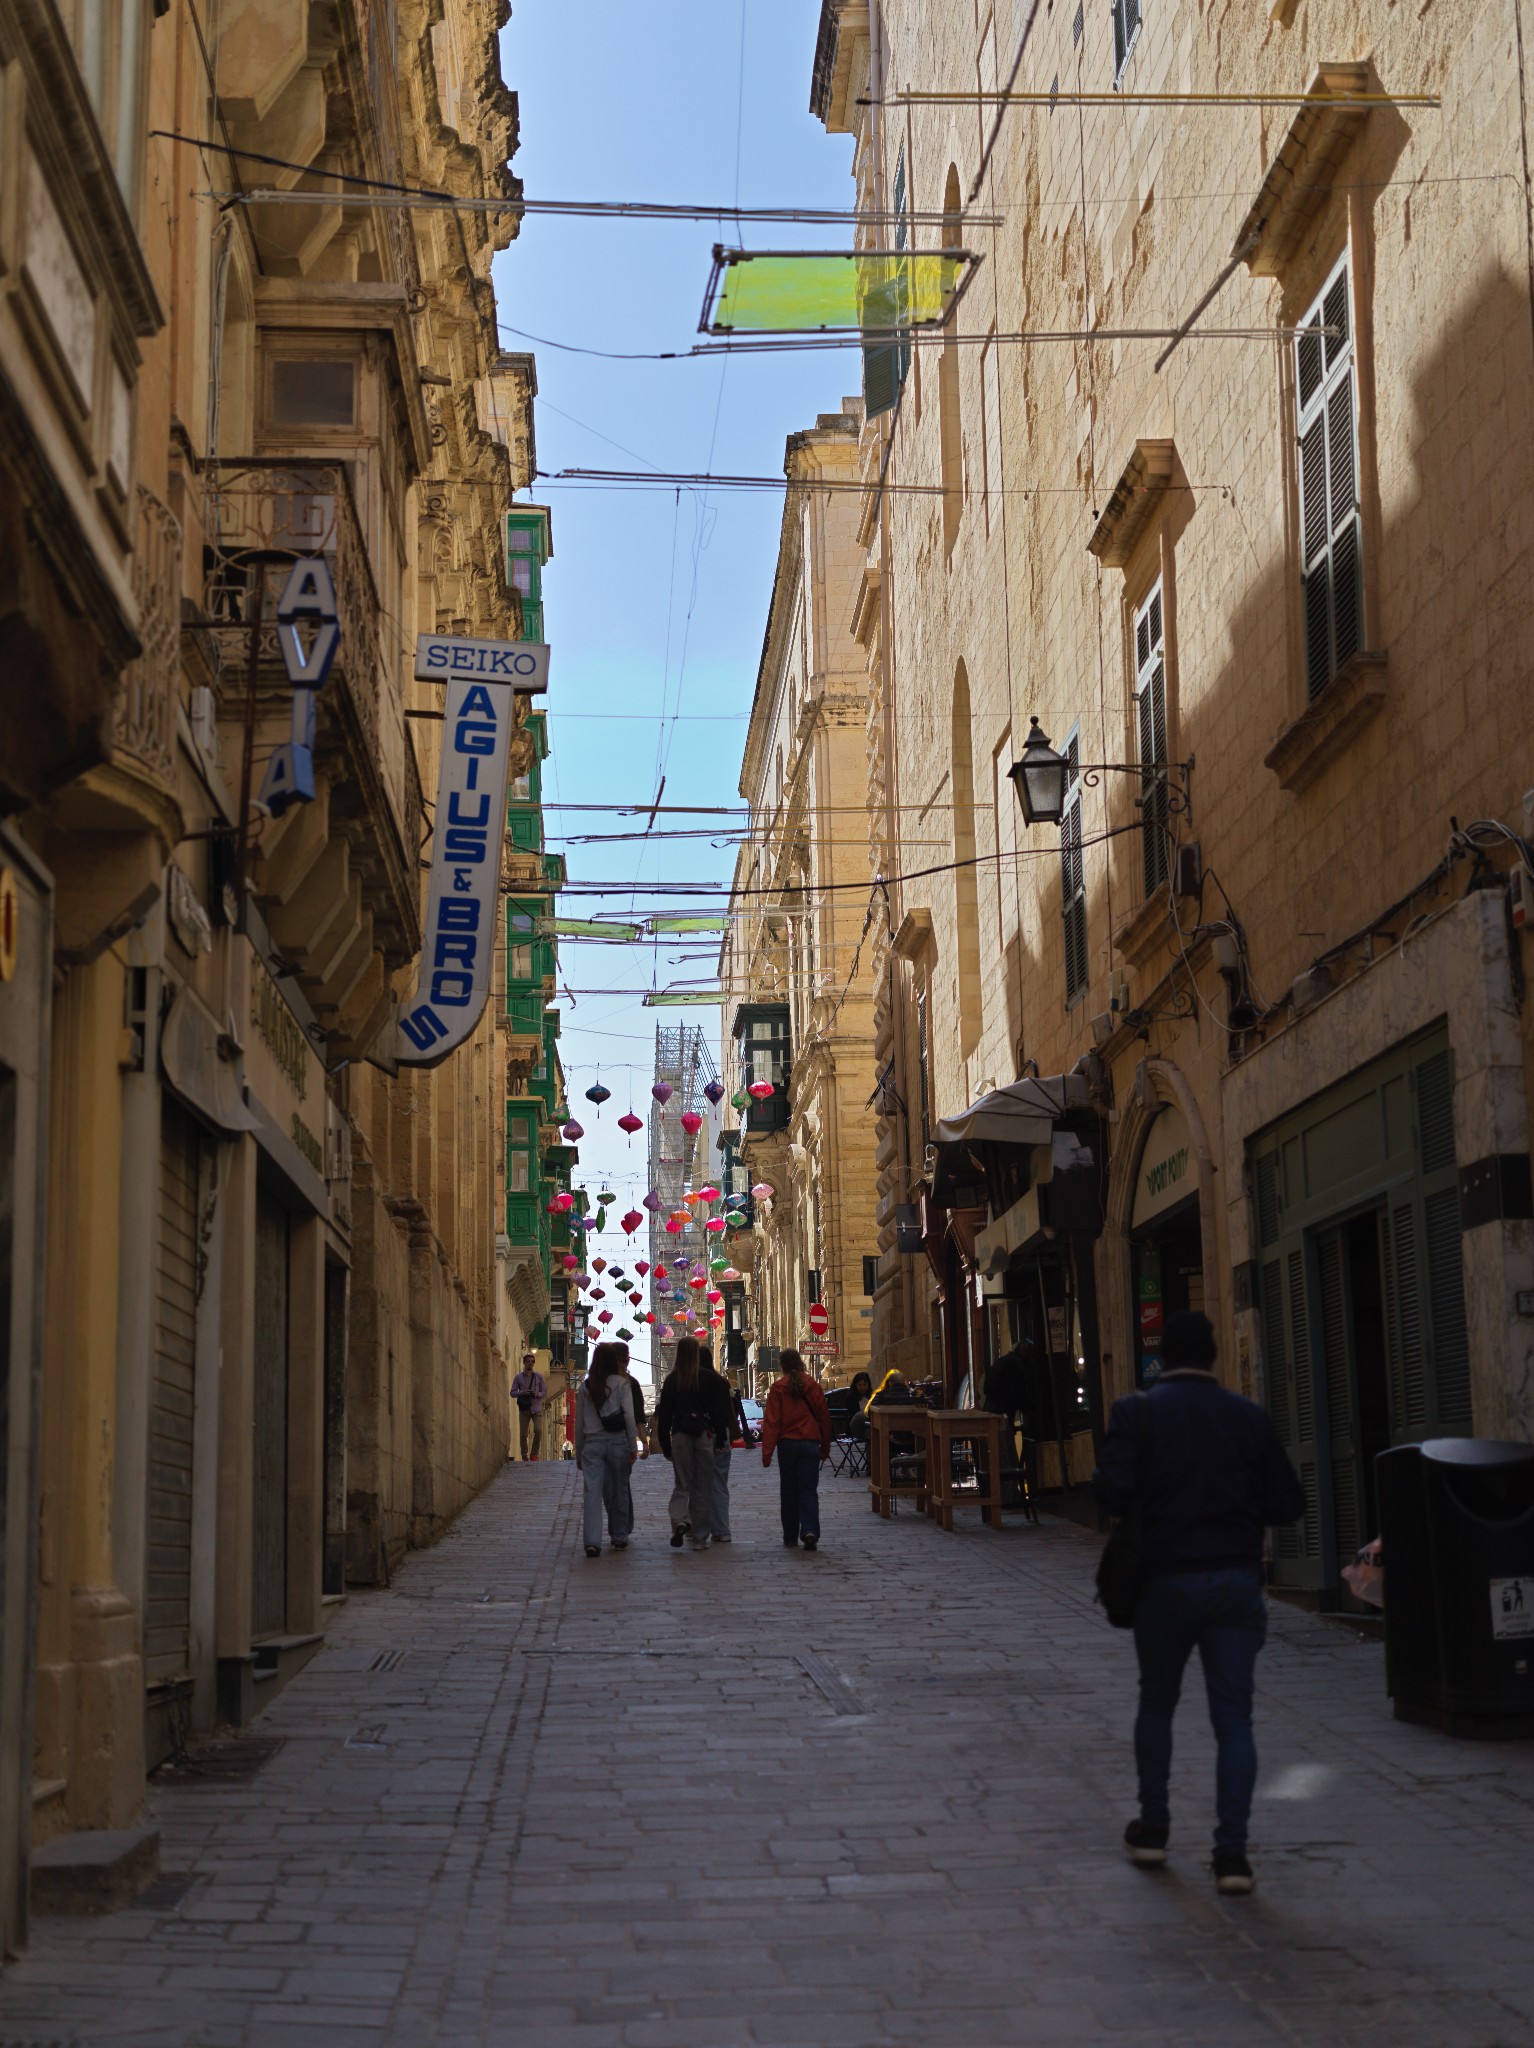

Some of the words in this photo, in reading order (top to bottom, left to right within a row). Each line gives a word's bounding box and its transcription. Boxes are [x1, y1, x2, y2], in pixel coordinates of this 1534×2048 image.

[427, 644, 537, 676] SEIKO
[445, 685, 498, 864] AGIUS
[453, 867, 474, 892] &
[399, 896, 481, 1051] BROS
[1168, 1147, 1185, 1184] POINT
[1144, 1307, 1159, 1317] NIKE
